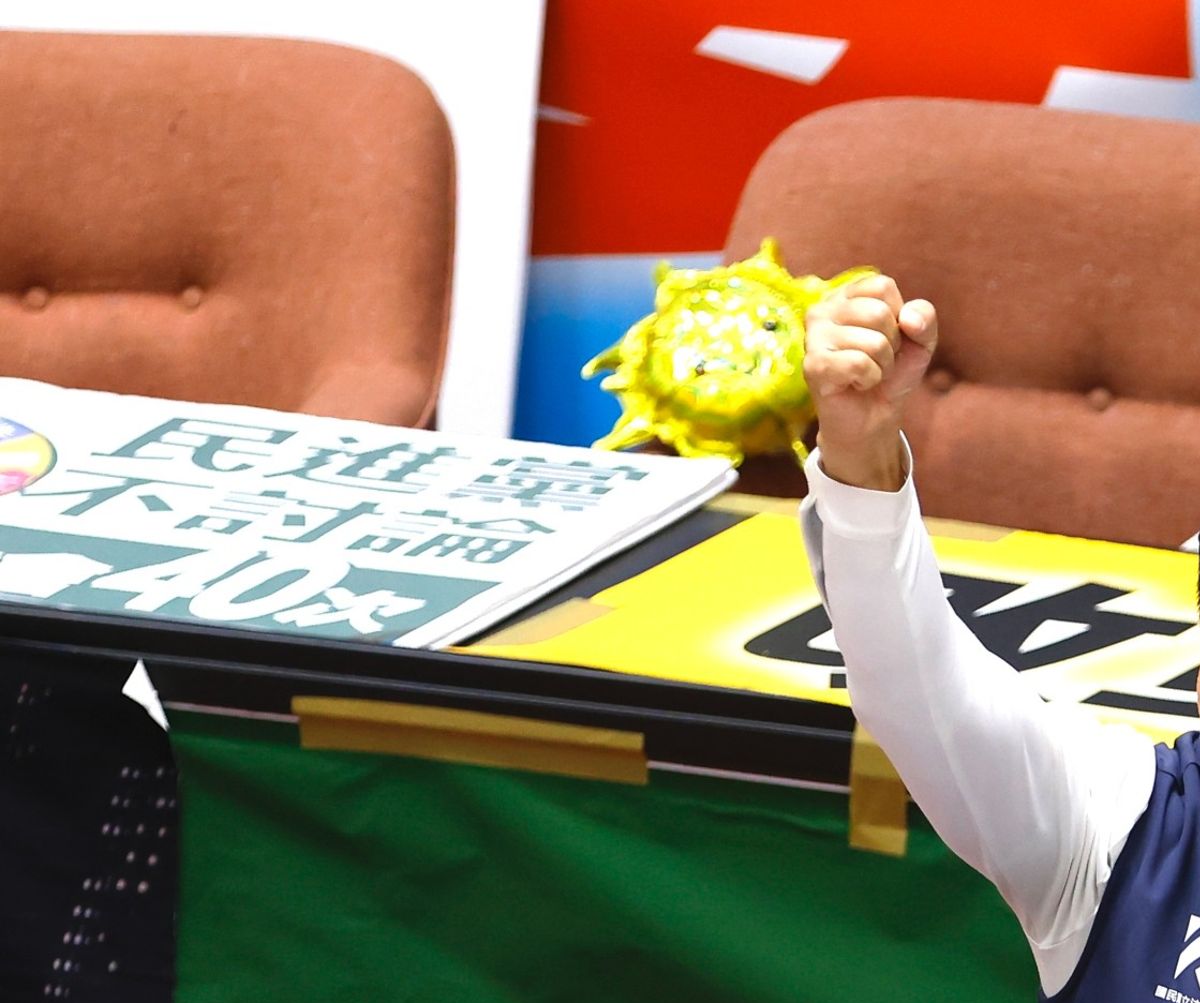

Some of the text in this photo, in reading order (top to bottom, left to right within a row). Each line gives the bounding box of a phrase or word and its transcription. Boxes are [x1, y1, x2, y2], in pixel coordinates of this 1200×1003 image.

[91, 417, 648, 511] 民進黨
[22, 468, 555, 563] 不討論
